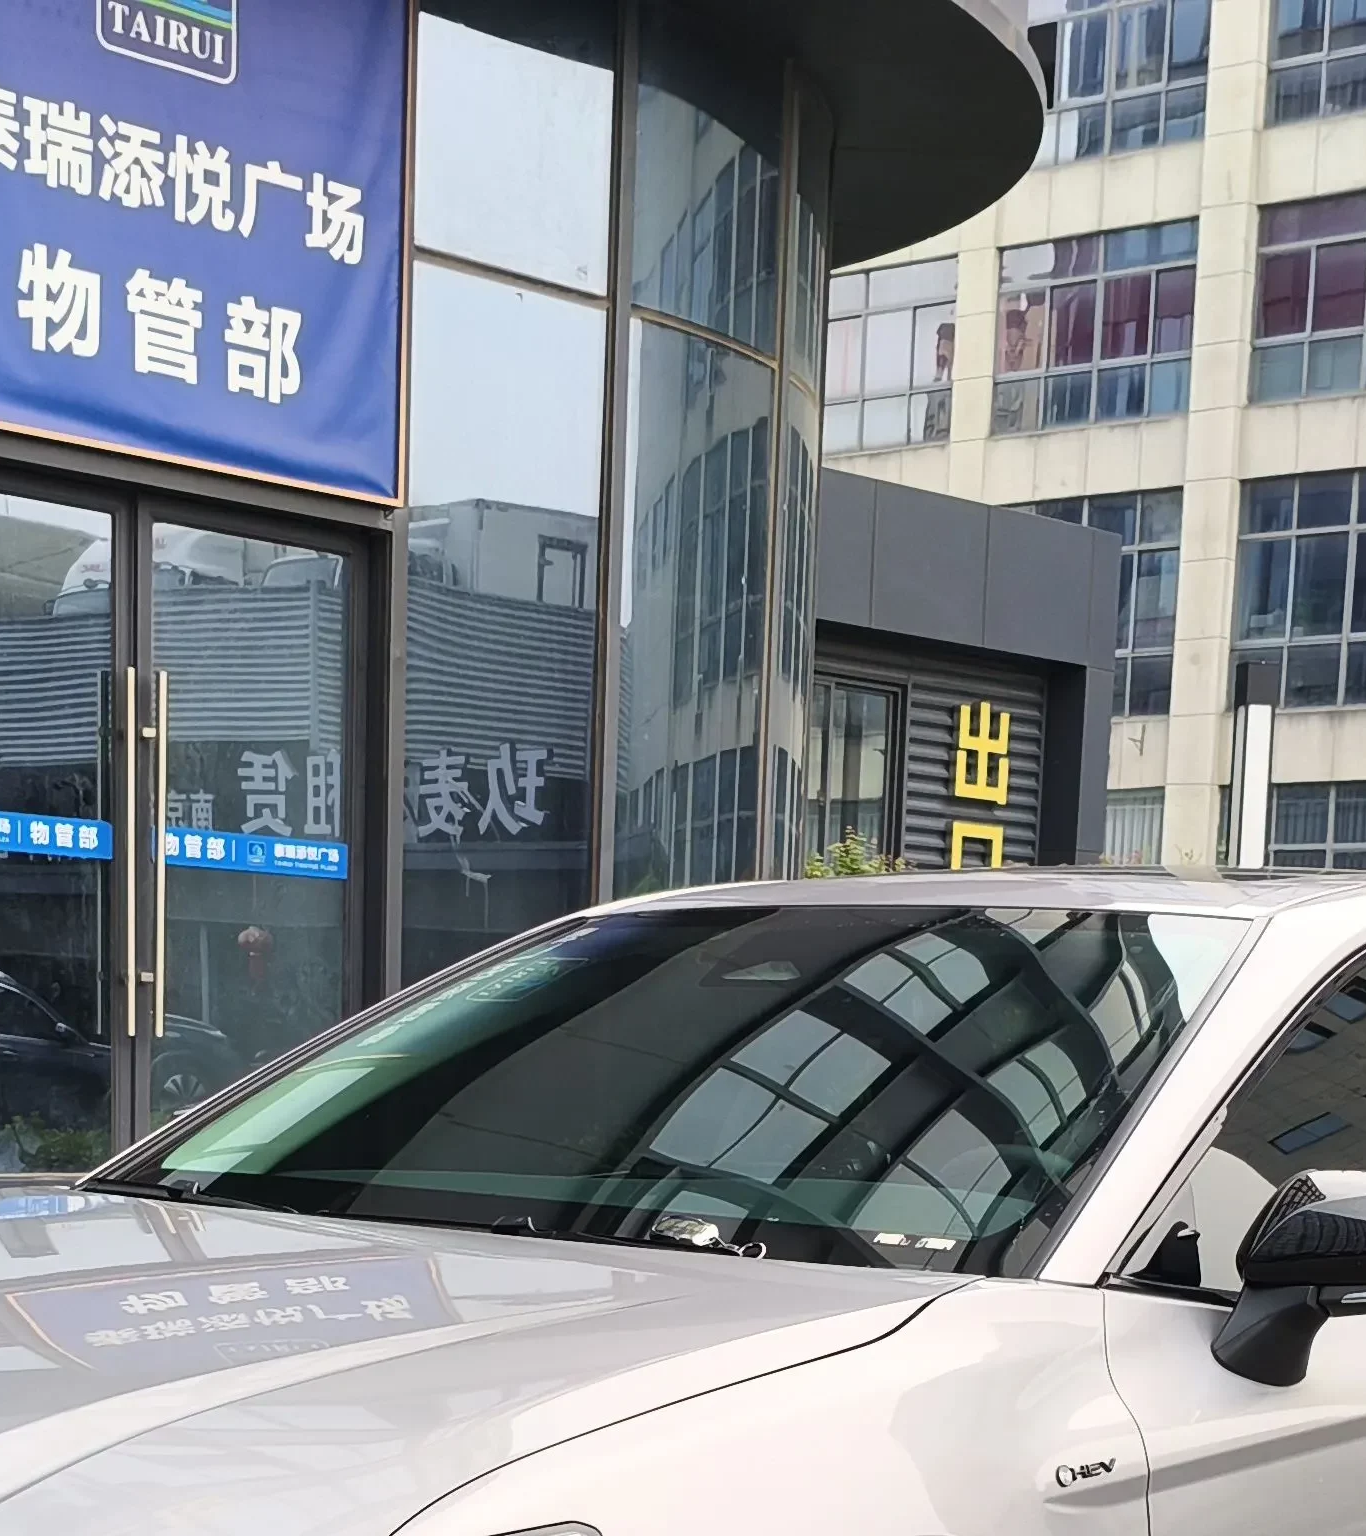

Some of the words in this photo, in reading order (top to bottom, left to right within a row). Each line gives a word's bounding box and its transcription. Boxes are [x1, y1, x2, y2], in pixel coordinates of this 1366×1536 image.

[107, 1, 226, 65] TAIRUI
[17, 242, 302, 406] 物管部
[29, 820, 99, 851] 物管部
